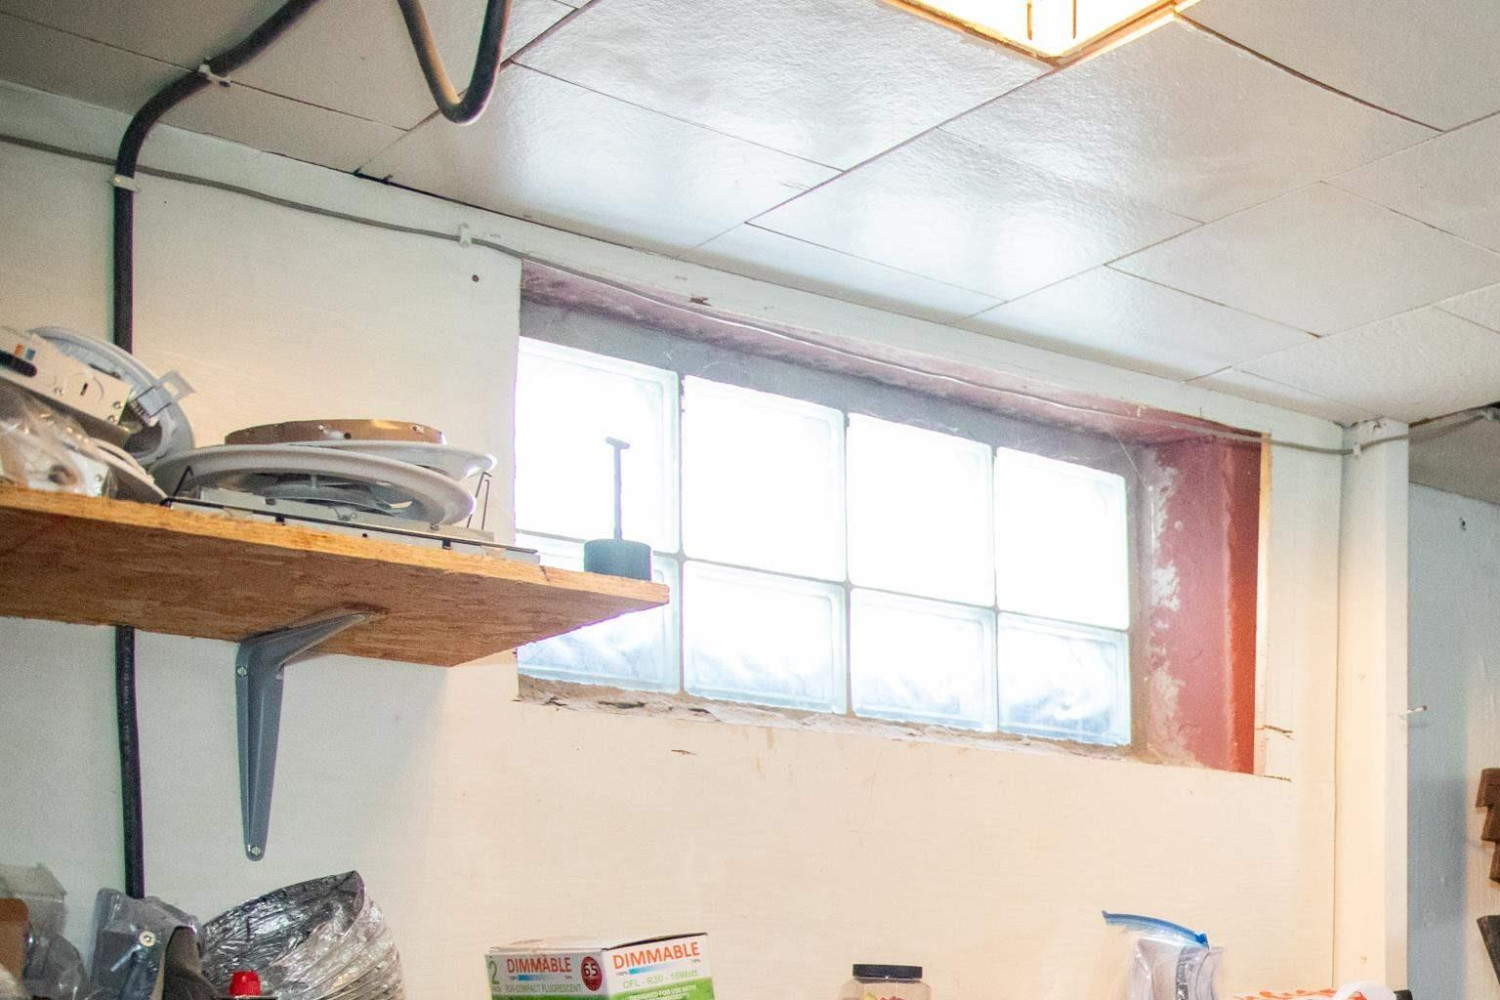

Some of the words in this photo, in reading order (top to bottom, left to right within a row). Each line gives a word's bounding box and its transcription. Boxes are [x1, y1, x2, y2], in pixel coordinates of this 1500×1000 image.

[612, 942, 700, 969] DIMMABLE
[507, 957, 572, 973] DIMMABLE
[583, 963, 598, 977] 65
